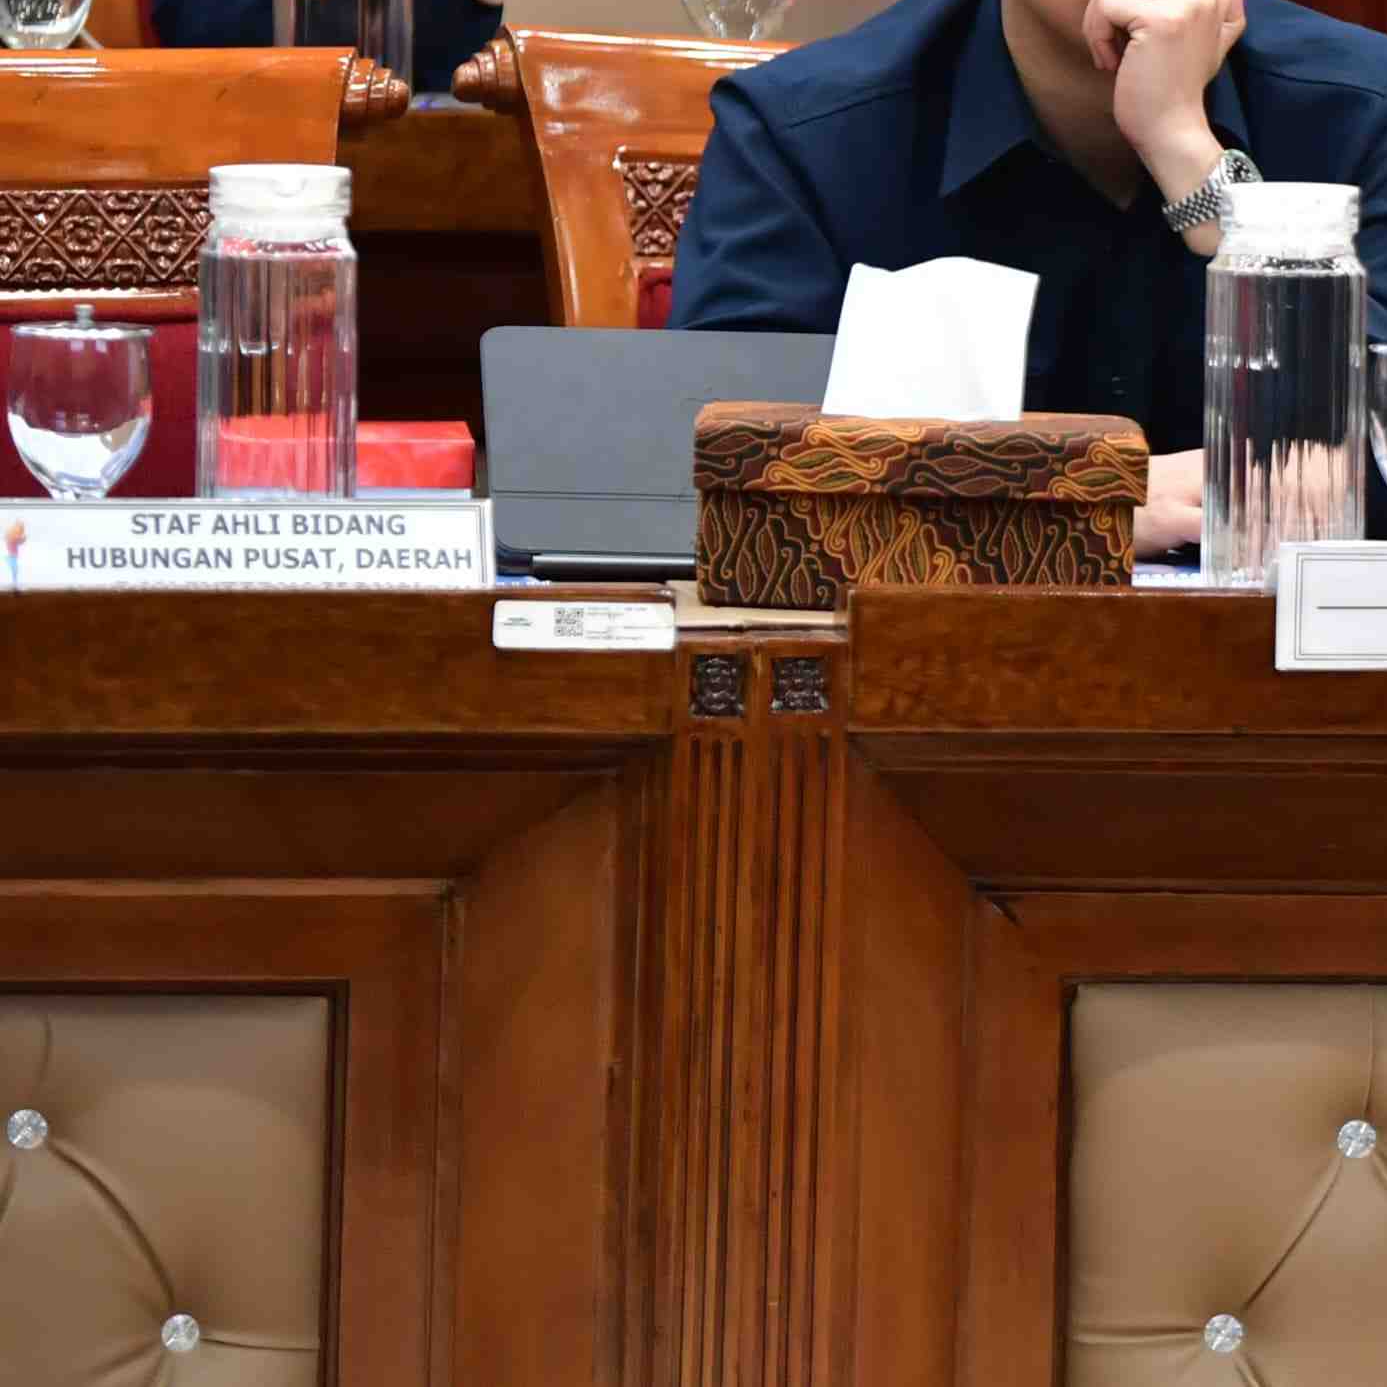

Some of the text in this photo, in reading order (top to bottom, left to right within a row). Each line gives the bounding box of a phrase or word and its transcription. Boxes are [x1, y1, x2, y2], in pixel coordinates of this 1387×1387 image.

[131, 513, 406, 536] STAF AHLI BIDANG
[66, 547, 472, 574] HUBUNGAN PUSAT, DAERAH
